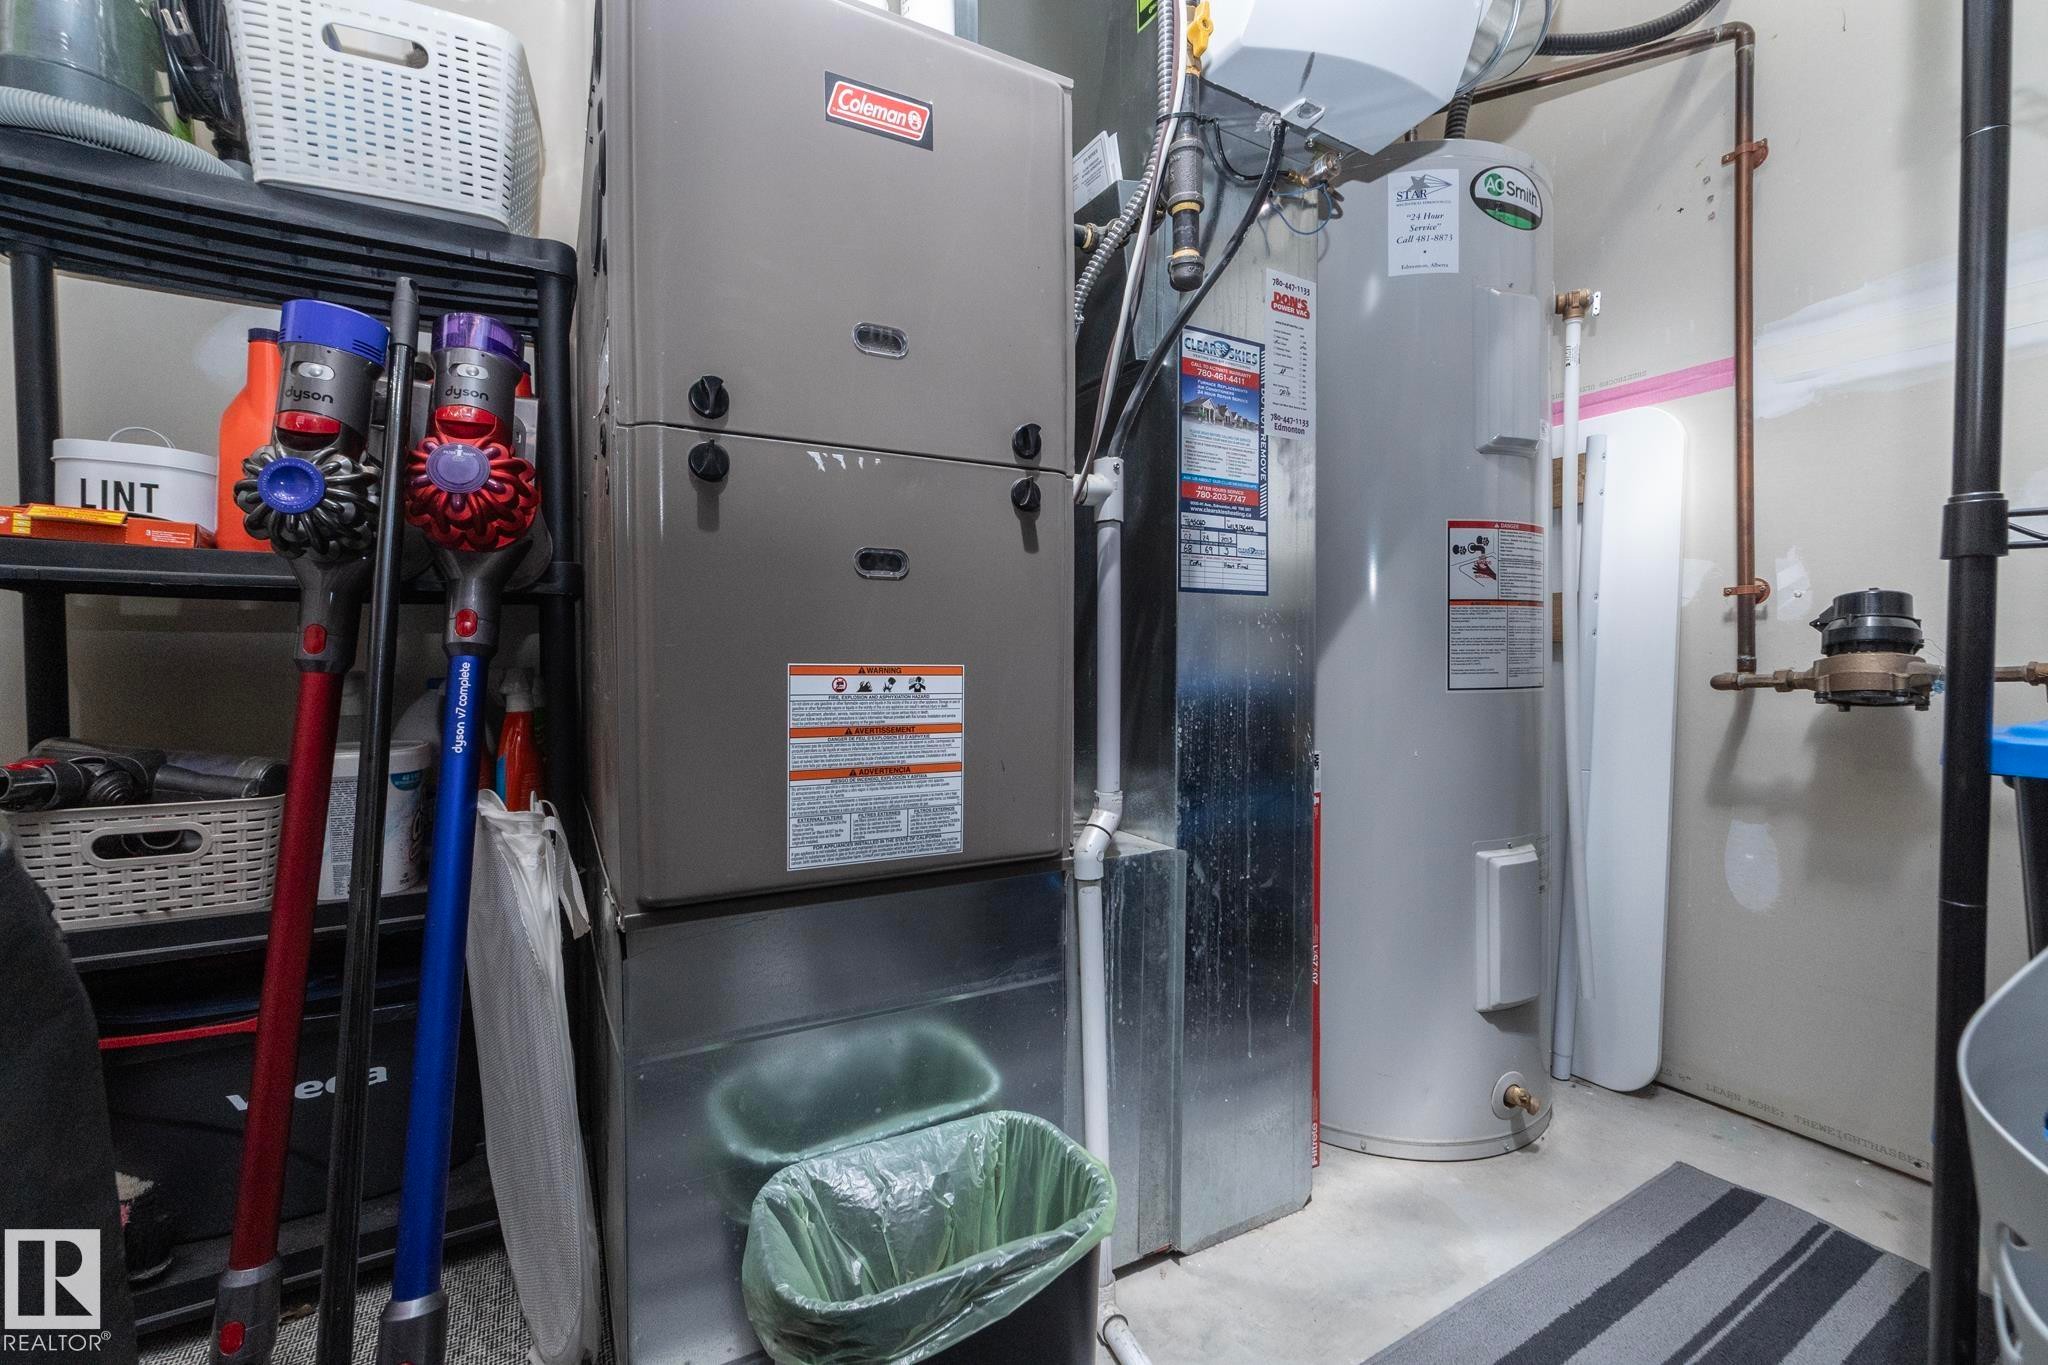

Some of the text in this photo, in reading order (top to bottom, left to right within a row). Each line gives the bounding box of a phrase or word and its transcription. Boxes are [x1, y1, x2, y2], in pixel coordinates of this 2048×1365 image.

[838, 89, 907, 126] Coleman
[1396, 190, 1427, 201] STAR
[1396, 236, 1414, 244] Call
[1272, 278, 1310, 296] 780-447-1133
[1273, 302, 1308, 318] POWER VAC
[1184, 337, 1258, 364] CLEAR SKIES
[1197, 369, 1245, 385] 780-461-4411
[285, 386, 334, 404] dyson
[445, 386, 488, 402] dyson
[1270, 413, 1310, 428] 780-447-1133
[1274, 423, 1306, 434] Edmonton
[80, 478, 159, 513] LINT
[1196, 490, 1246, 503] 780-203-7747
[452, 662, 472, 754] dyson v7 complete
[855, 726, 916, 734] AVERTISSEMENT
[858, 766, 910, 776] ADVERTENCIA
